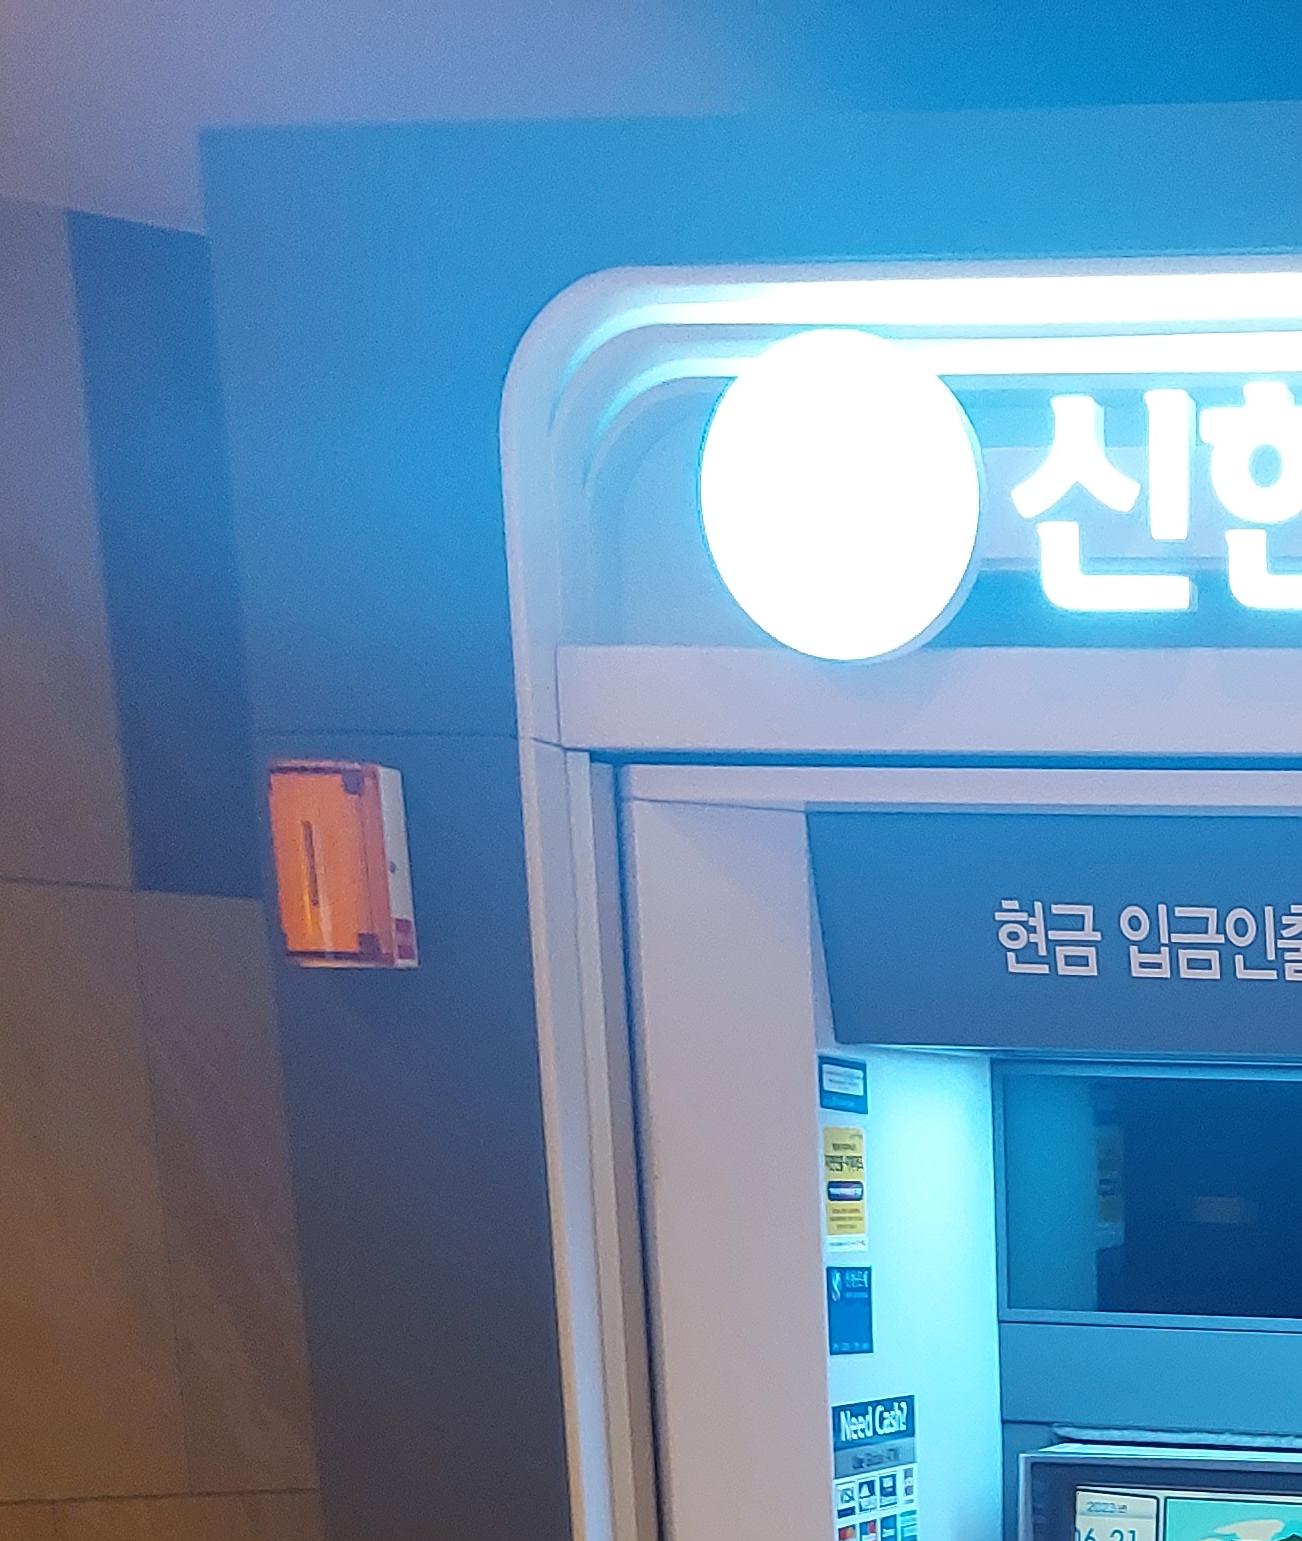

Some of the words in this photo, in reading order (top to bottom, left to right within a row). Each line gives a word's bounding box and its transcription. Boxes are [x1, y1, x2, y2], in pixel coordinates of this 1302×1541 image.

[993, 897, 1102, 978] 현금
[839, 1405, 874, 1442] Need
[874, 1400, 908, 1436] Cash?
